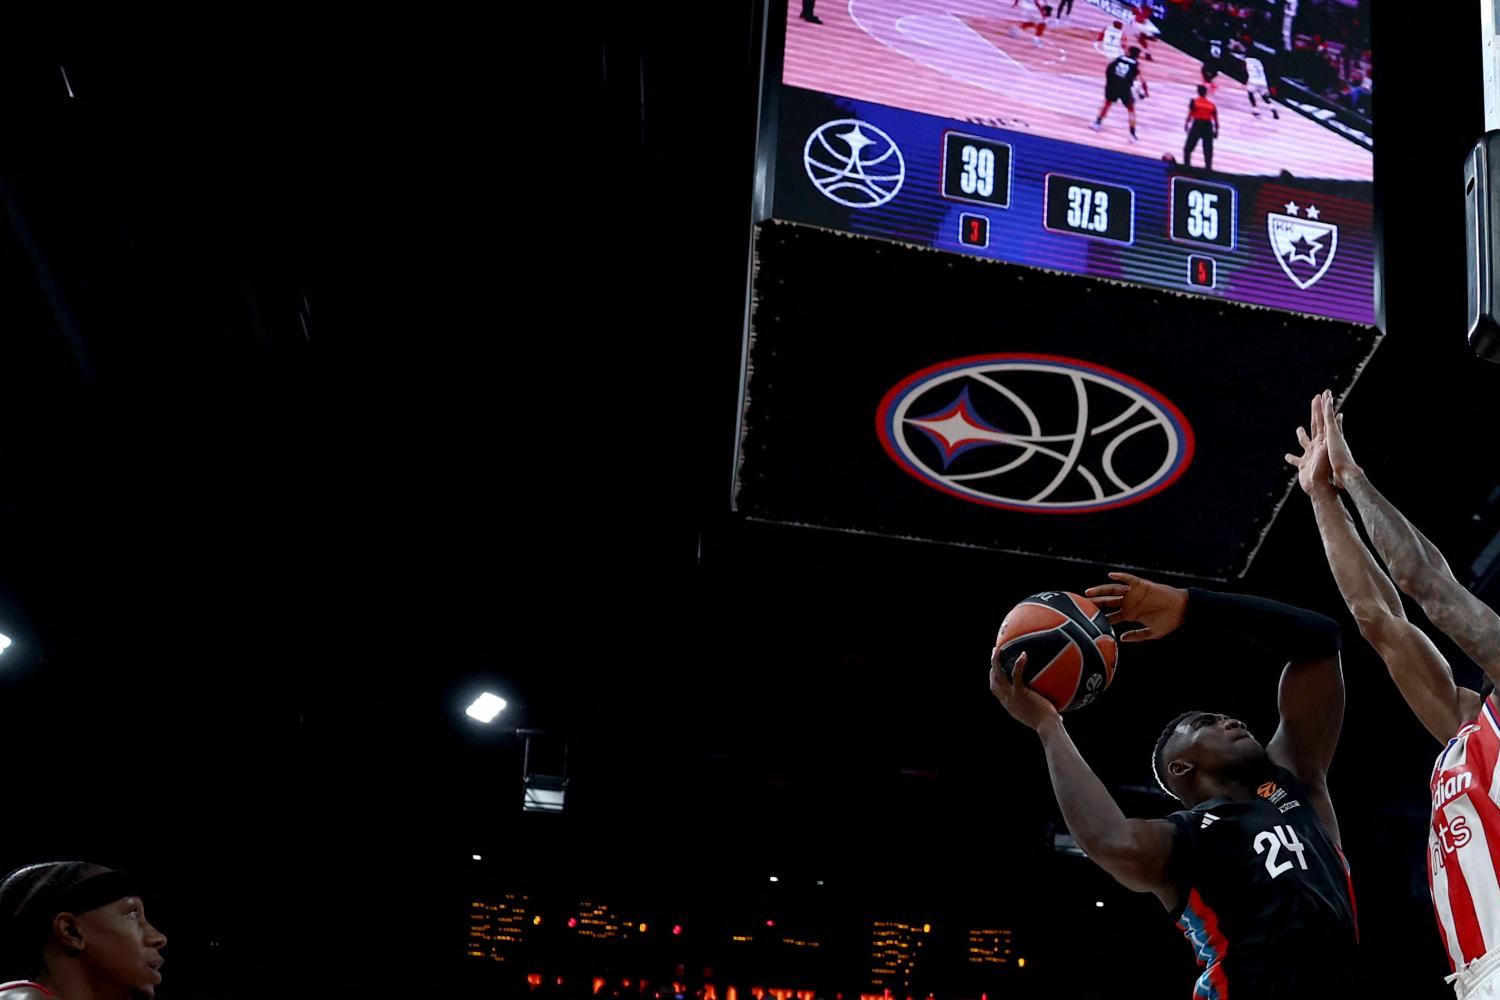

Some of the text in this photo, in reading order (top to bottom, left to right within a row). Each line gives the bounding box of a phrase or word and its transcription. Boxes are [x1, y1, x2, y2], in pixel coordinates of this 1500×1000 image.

[960, 144, 995, 197] 39
[969, 219, 980, 242] 3
[1067, 185, 1109, 233] 37.3
[1187, 189, 1219, 240] 35
[1434, 771, 1472, 811] dian
[1253, 825, 1308, 879] 24
